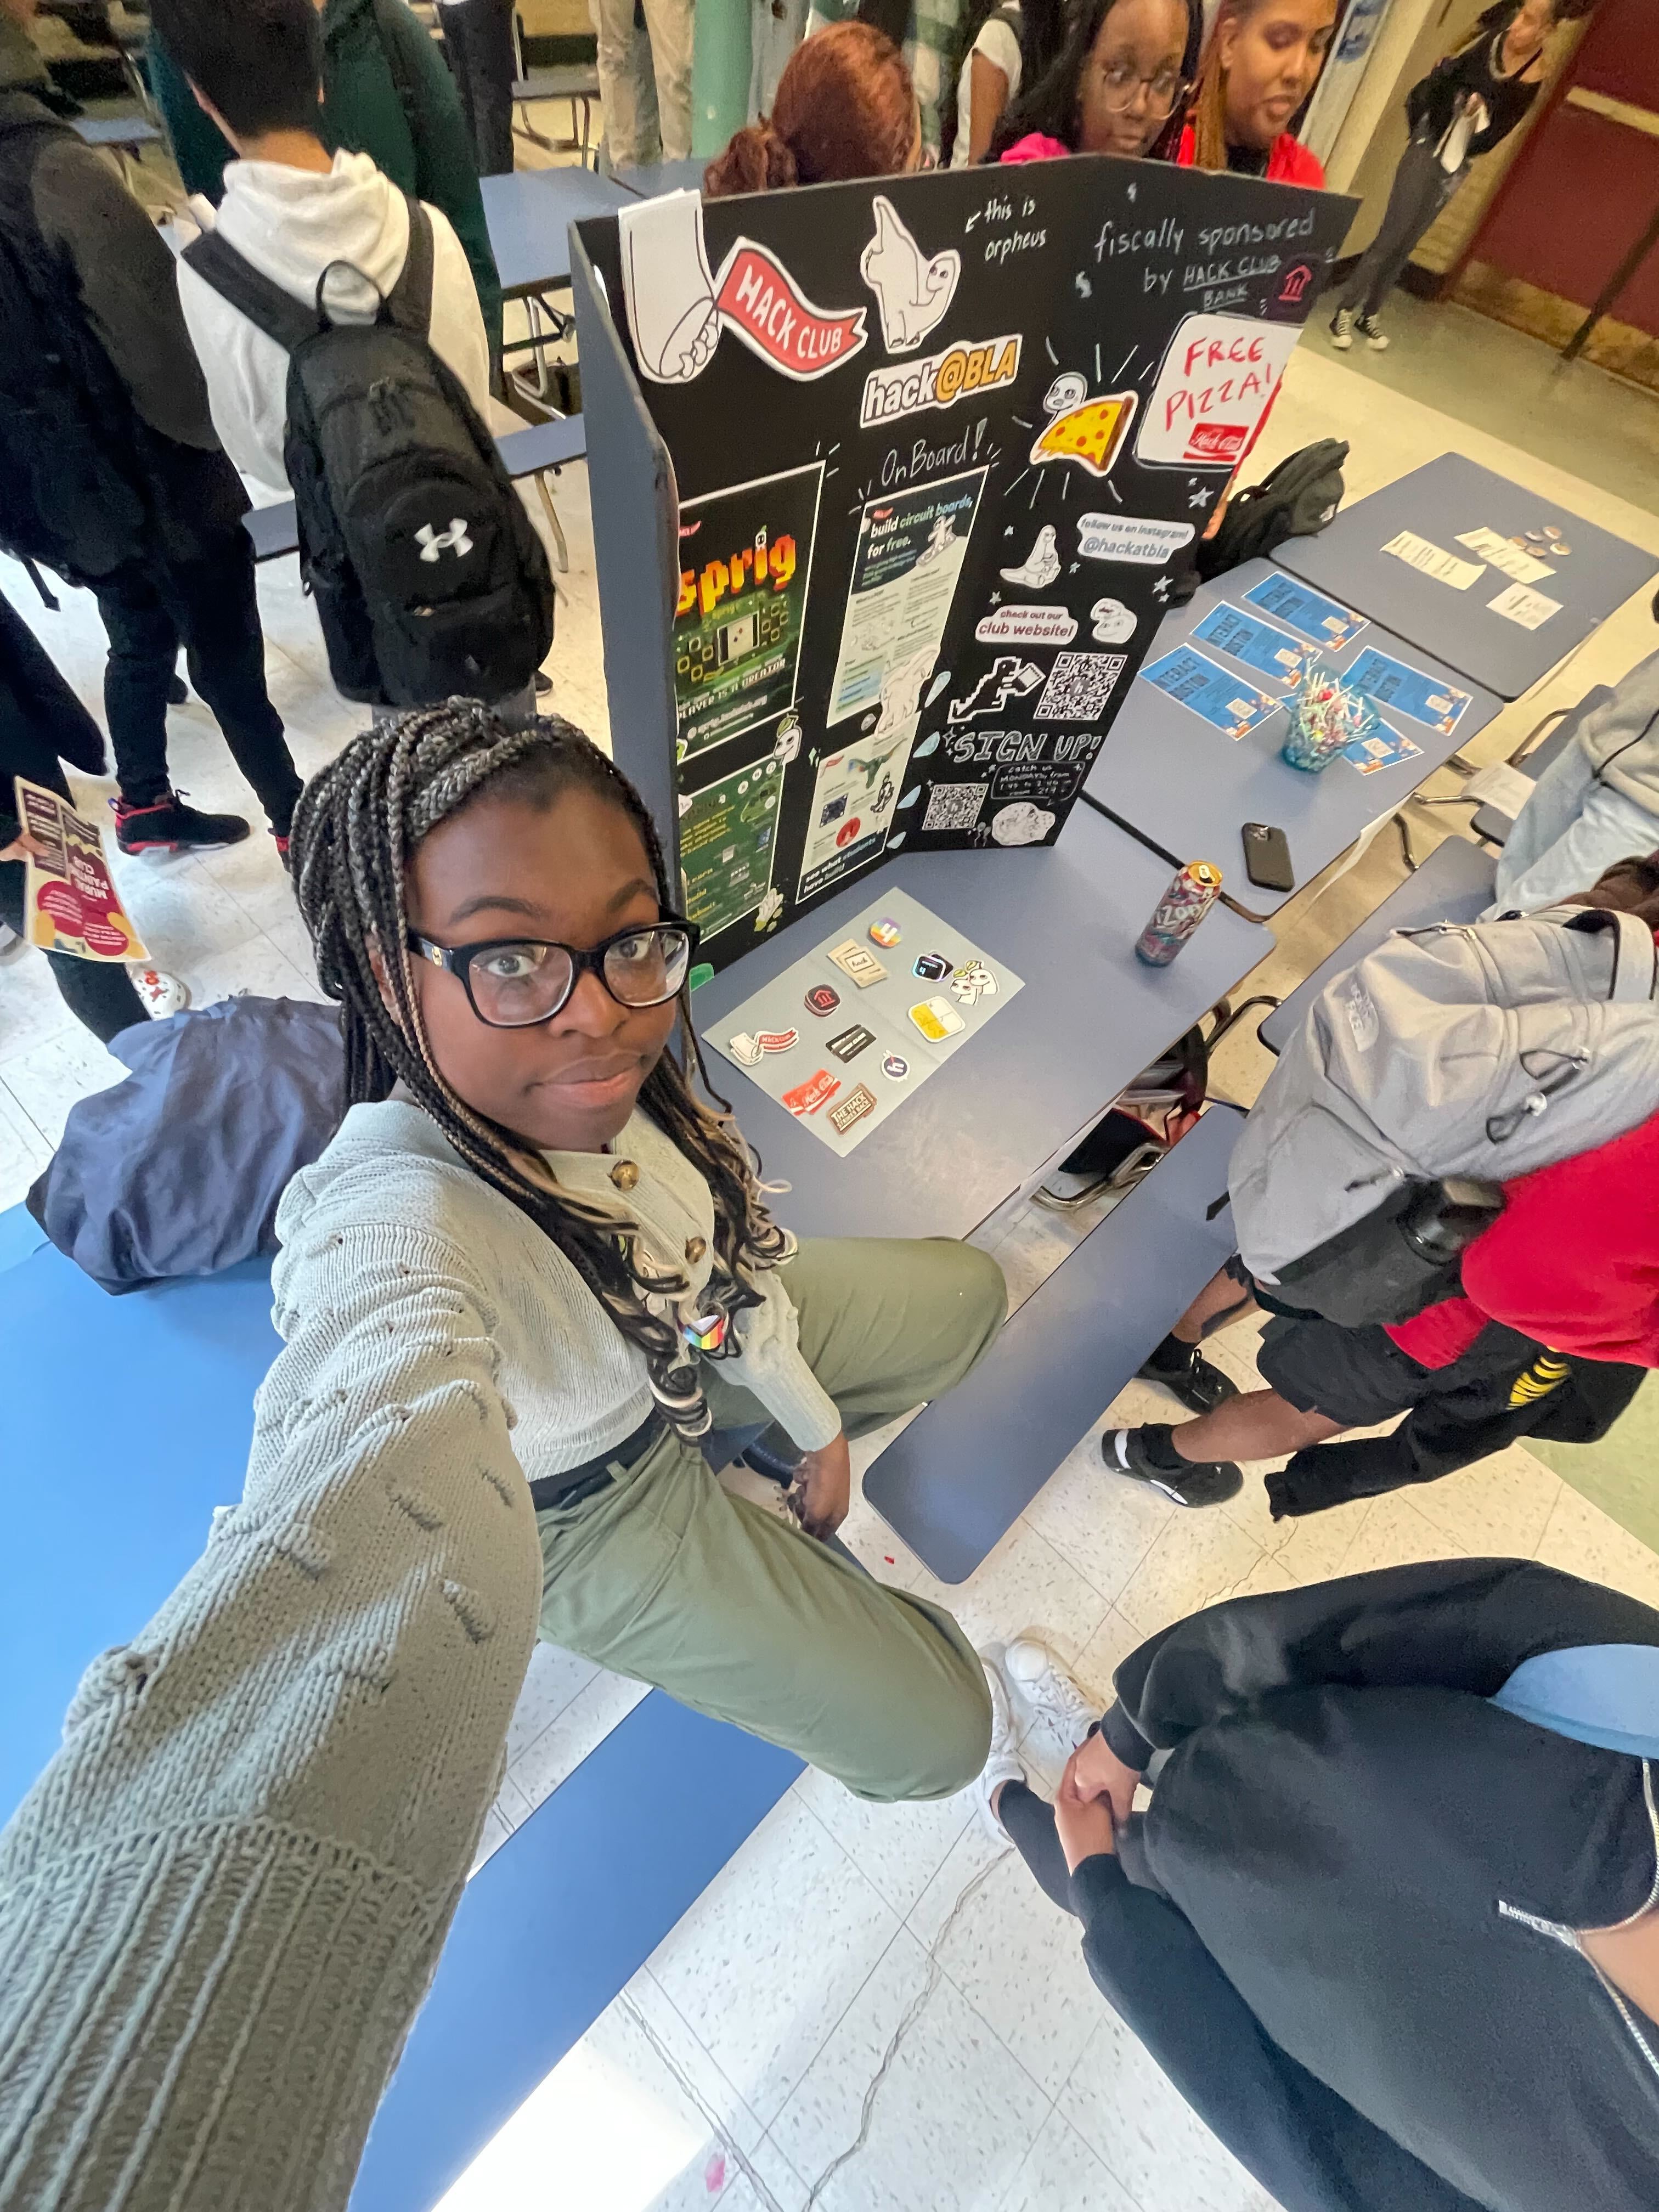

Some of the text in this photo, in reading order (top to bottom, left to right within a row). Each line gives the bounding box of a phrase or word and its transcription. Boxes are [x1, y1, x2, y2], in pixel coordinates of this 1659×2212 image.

[984, 195, 1036, 221] this is
[984, 229, 1047, 264] orpheus
[1095, 207, 1315, 263] fiscally sponsored
[1144, 254, 1282, 295] by HACK CLUB
[736, 264, 843, 360] HACK CLUB
[1203, 286, 1248, 308] BANK
[1183, 336, 1266, 377] FREE
[864, 340, 1019, 420] hack@BLA
[1165, 364, 1272, 432] PIZZA!
[870, 515, 899, 538] build
[899, 504, 934, 529] circuit
[1080, 518, 1111, 530] follow
[867, 544, 885, 560] for
[1084, 536, 1170, 558] @hackatbla
[979, 623, 1074, 637] club website!
[1000, 608, 1063, 620] check out our
[953, 730, 1103, 763] SIGN UP!
[831, 1093, 866, 1123] THE HACK
